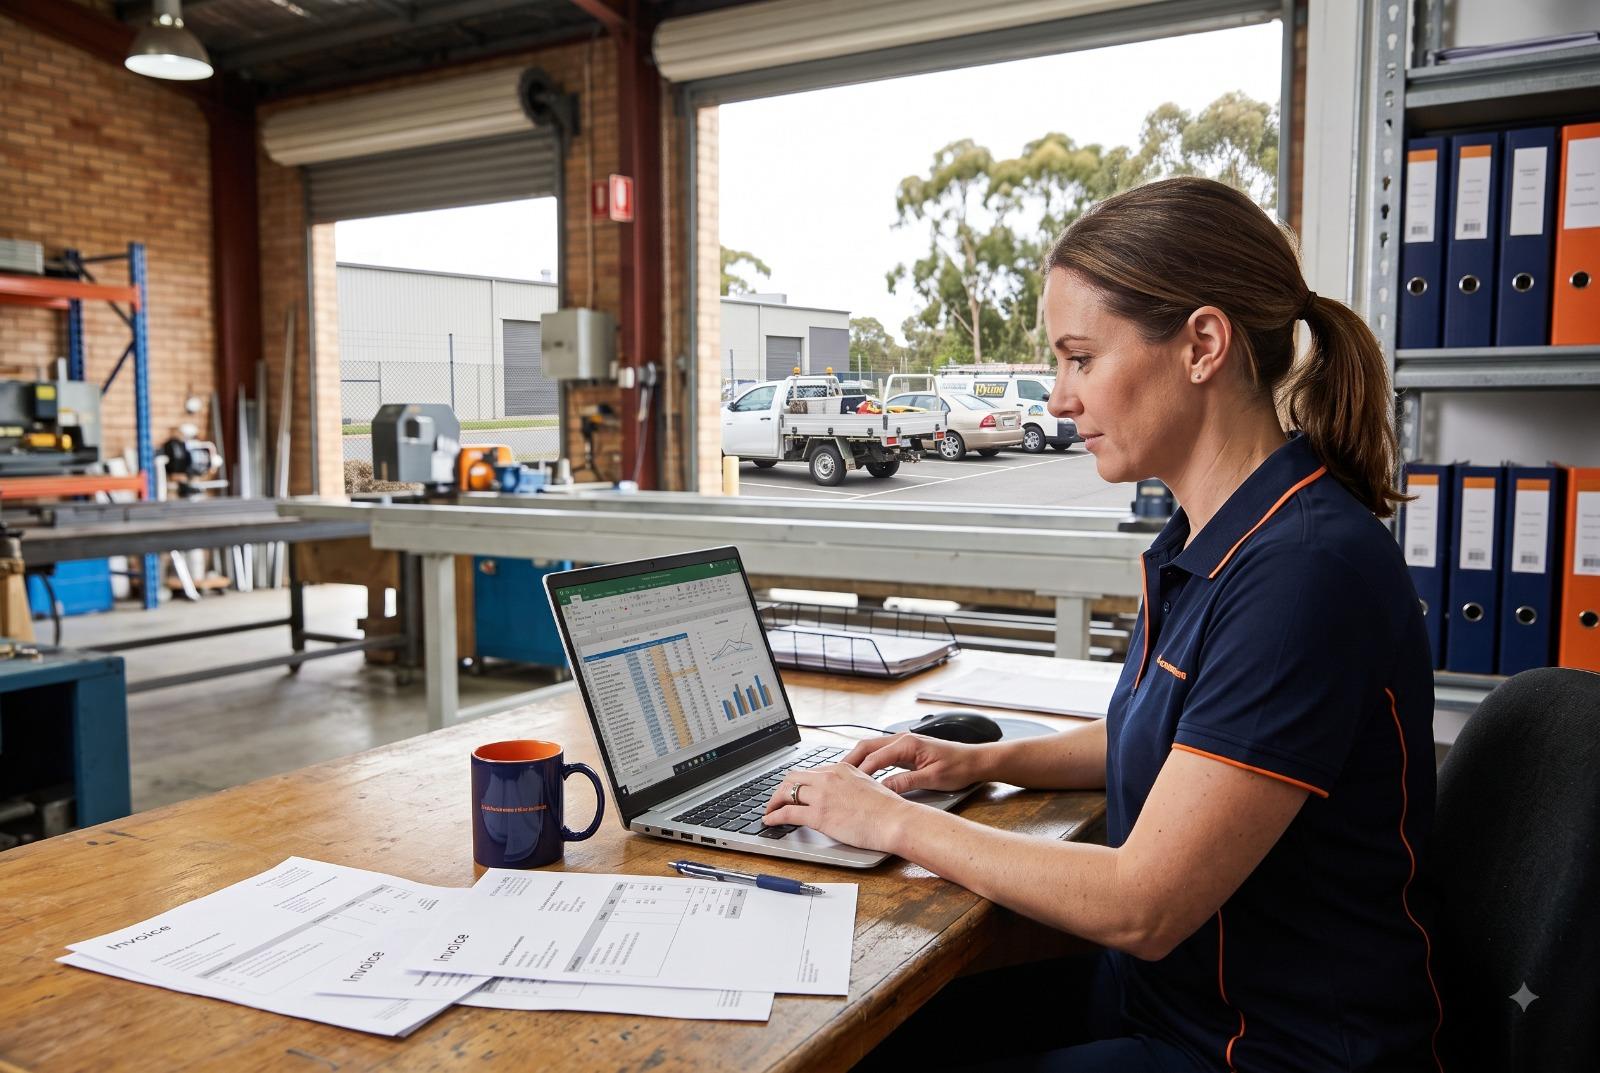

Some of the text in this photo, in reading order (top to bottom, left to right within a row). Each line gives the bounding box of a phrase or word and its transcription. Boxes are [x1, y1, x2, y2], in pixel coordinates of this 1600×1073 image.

[106, 926, 172, 950] Invoice
[433, 934, 470, 962] Invoice
[343, 951, 385, 982] Invoice
